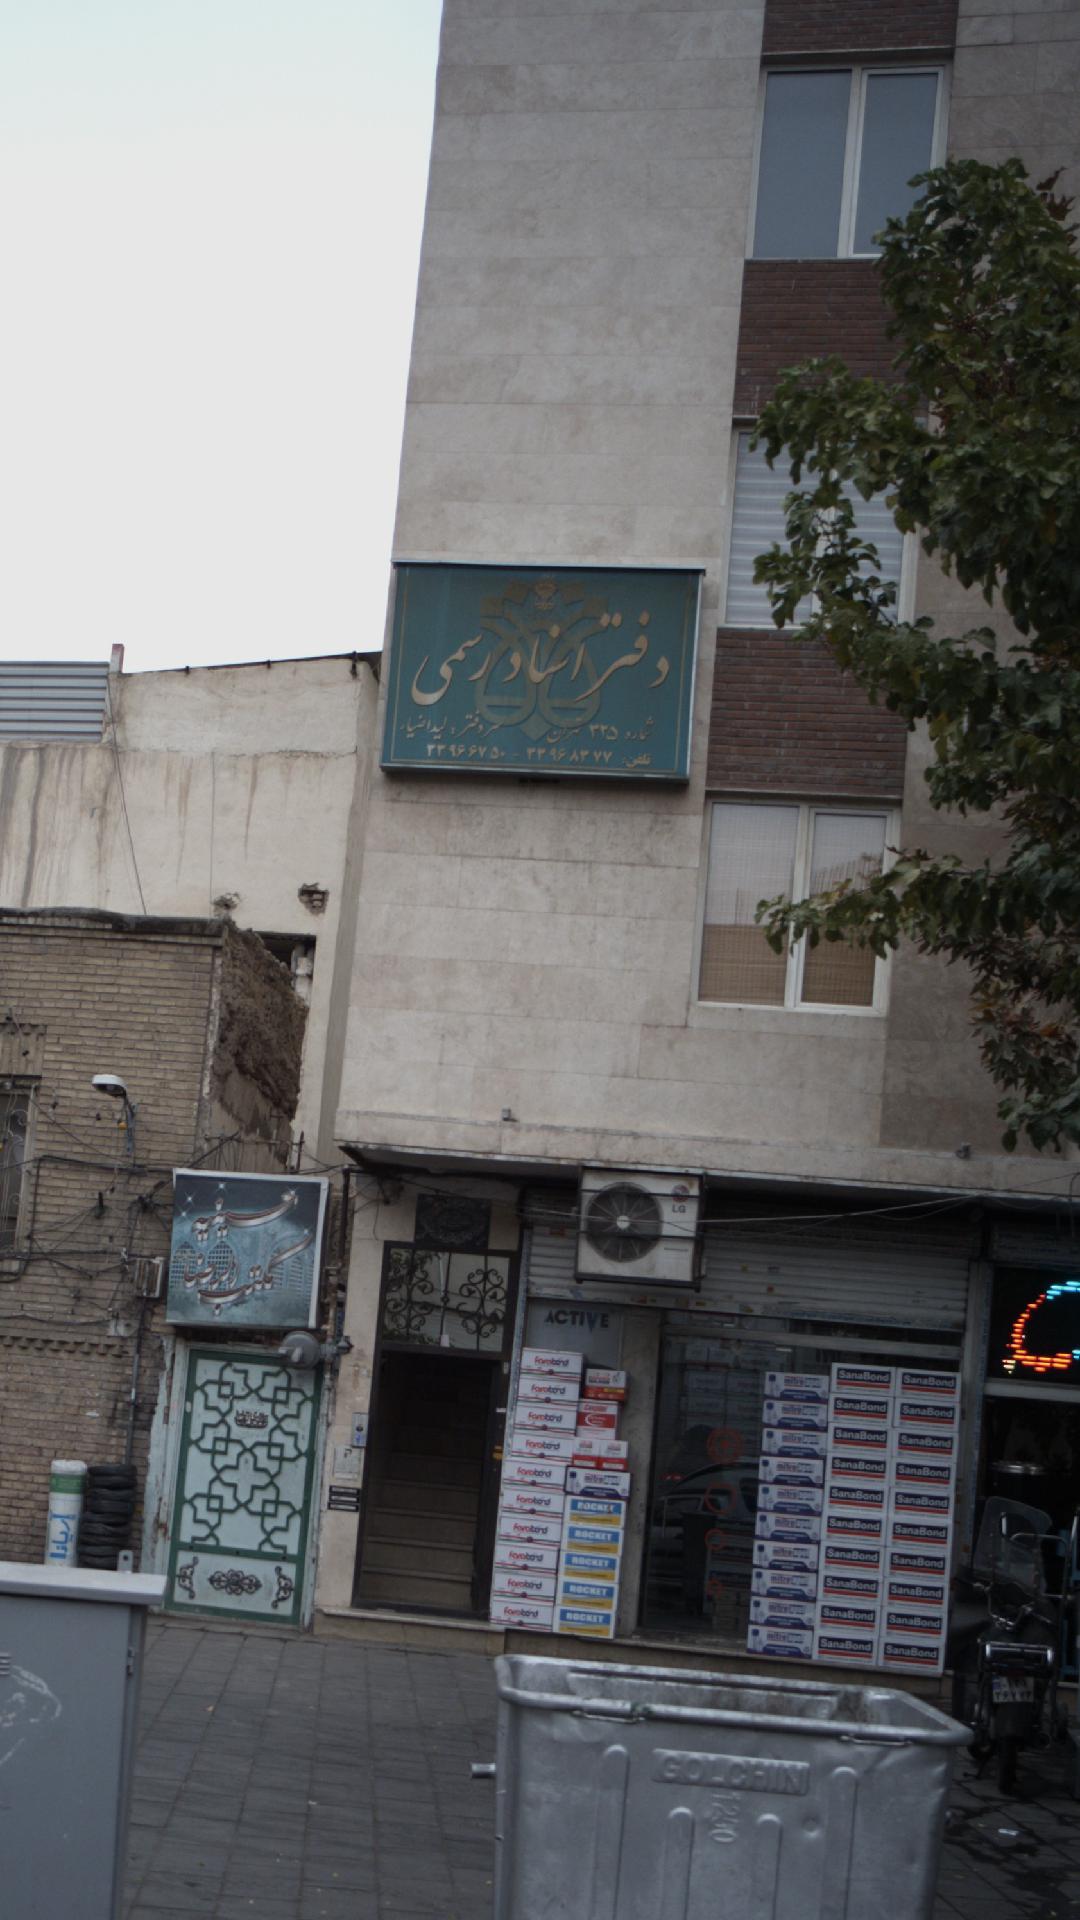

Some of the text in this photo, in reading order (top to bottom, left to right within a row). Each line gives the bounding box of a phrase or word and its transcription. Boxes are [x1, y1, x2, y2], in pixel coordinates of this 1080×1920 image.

[410, 610, 671, 706] دفتر اسناد رسمی
[671, 1204, 687, 1214] LG
[544, 1310, 609, 1333] ACTIVE
[839, 1370, 889, 1382] SanaBond
[904, 1375, 954, 1387] SanaBond
[836, 1400, 886, 1412] SanaBond
[903, 1406, 953, 1418] SanaBond
[836, 1429, 886, 1441] SanaBond
[901, 1436, 951, 1448] SanaBond
[834, 1459, 884, 1471] SanaBond
[898, 1465, 948, 1477] SanaBond
[832, 1489, 882, 1501] SanaBond
[897, 1495, 947, 1507] SanaBond
[830, 1518, 880, 1530] SanaBond
[575, 1528, 612, 1541] ROCKET
[895, 1525, 945, 1537] SanaBond
[572, 1555, 609, 1567] ROCKET
[828, 1549, 878, 1561] SanaBond
[893, 1556, 943, 1568] SanaBond
[569, 1583, 608, 1596] ROCKET
[826, 1578, 876, 1590] SanaBond
[891, 1585, 941, 1597] SanaBond
[566, 1611, 604, 1623] ROCKET
[823, 1608, 873, 1620] SanaBond
[889, 1615, 939, 1627] SanaBond
[821, 1639, 871, 1651] SanaBond
[886, 1646, 936, 1658] SanaBond
[663, 1756, 801, 1793] GOLCHIN
